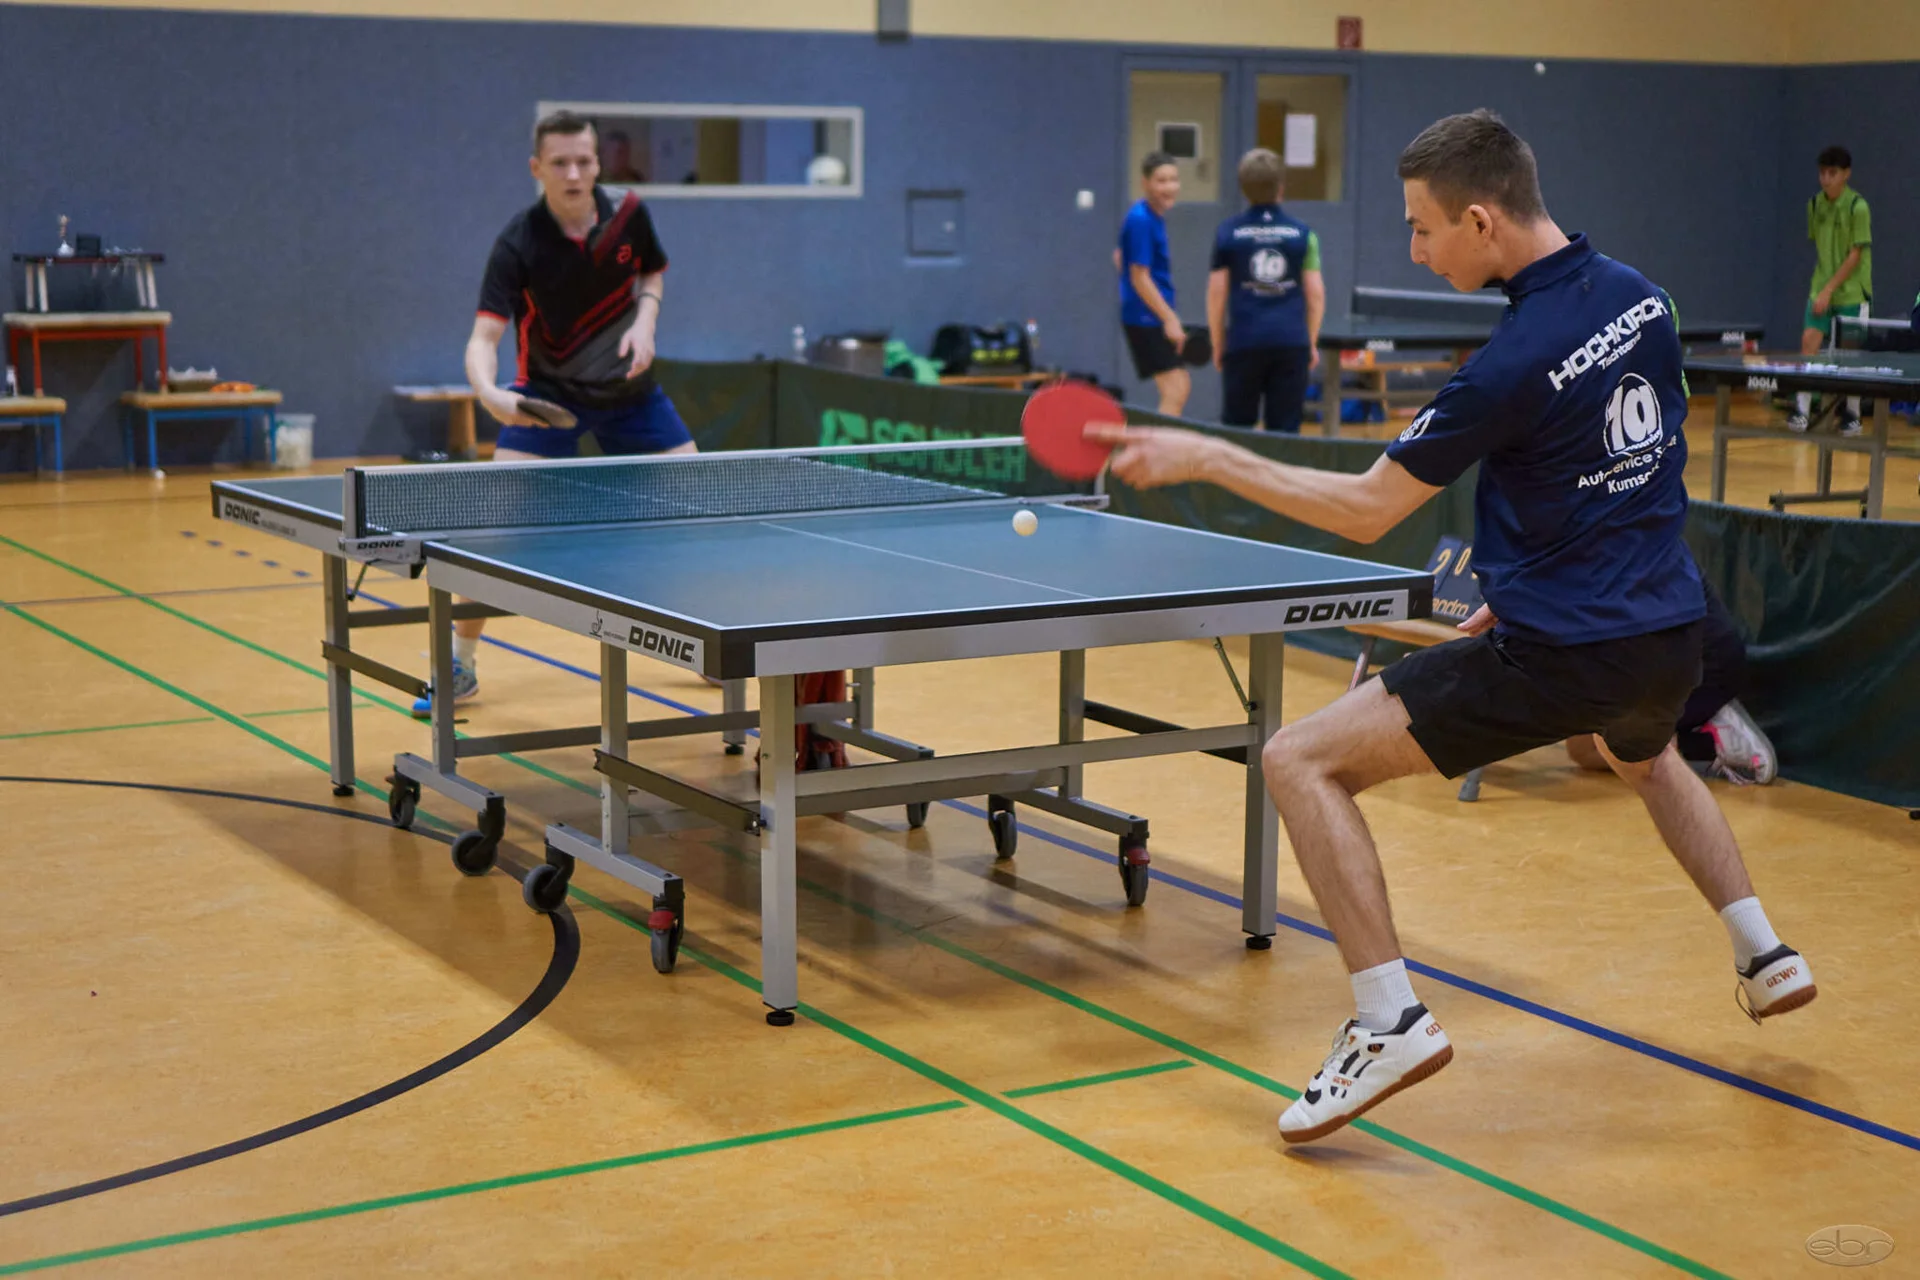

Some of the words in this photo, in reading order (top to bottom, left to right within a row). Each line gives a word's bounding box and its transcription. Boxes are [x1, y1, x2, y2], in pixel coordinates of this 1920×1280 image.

[1548, 296, 1668, 391] HOCHKIRCH
[1748, 376, 1778, 391] JOOLA
[225, 501, 260, 525] DONIC
[357, 540, 405, 550] DONIC
[1284, 598, 1394, 624] DONIC
[628, 625, 695, 663] DONIC
[1765, 966, 1798, 988] GEWO
